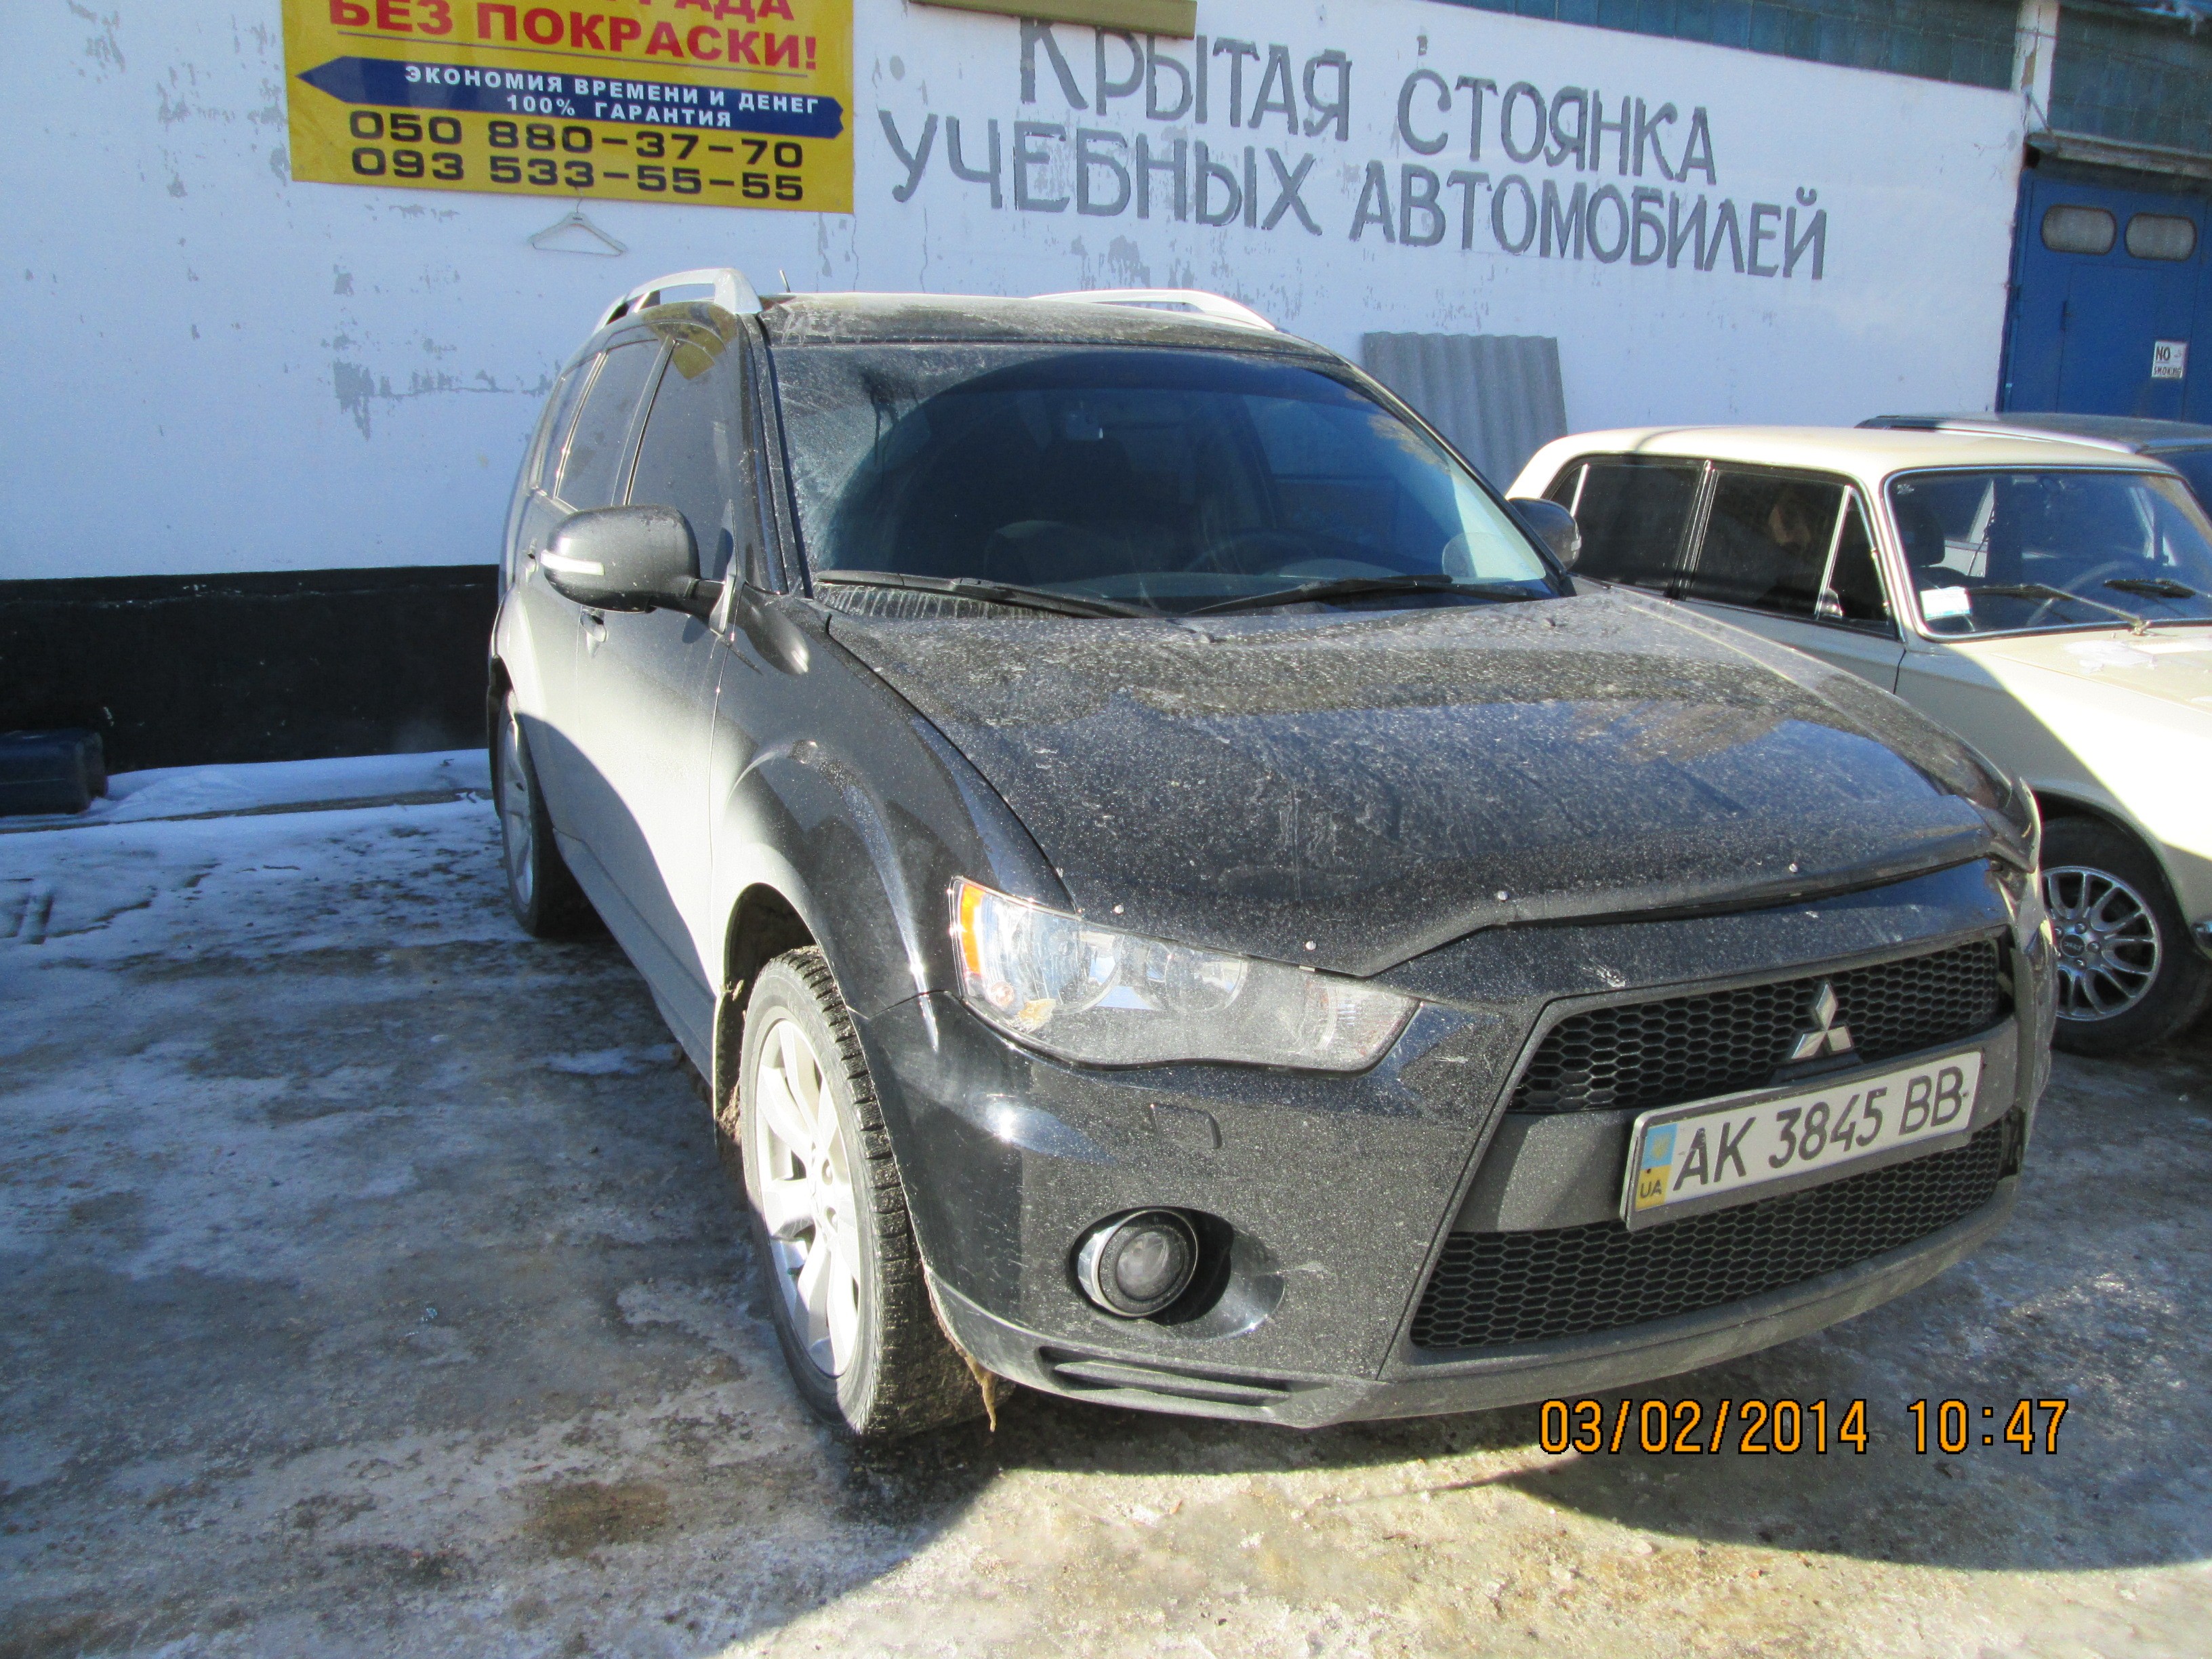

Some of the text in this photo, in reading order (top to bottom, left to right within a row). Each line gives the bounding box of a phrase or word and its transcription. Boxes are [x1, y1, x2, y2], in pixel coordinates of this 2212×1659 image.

[329, 0, 453, 35] БЕЗ
[476, 2, 817, 70] ПОКРАСКИ!
[405, 66, 819, 114] ЭКОНОМИЯ ВРЕМЕНИ И ДЕНЕГ
[507, 94, 731, 127] 100% ГАРАНТИЯ
[1020, 18, 1717, 185] КРЫТАЯ СТОЯНКА
[350, 110, 803, 168] 050 880-37-70
[352, 147, 803, 201] 093 533-55-55
[879, 109, 1827, 280] УЧЕБНЫХ АВТОМОБИЛЕЙ
[2155, 346, 2171, 361] NO
[1673, 1065, 1965, 1191] AK 3845 BB
[1639, 1179, 1663, 1199] UA
